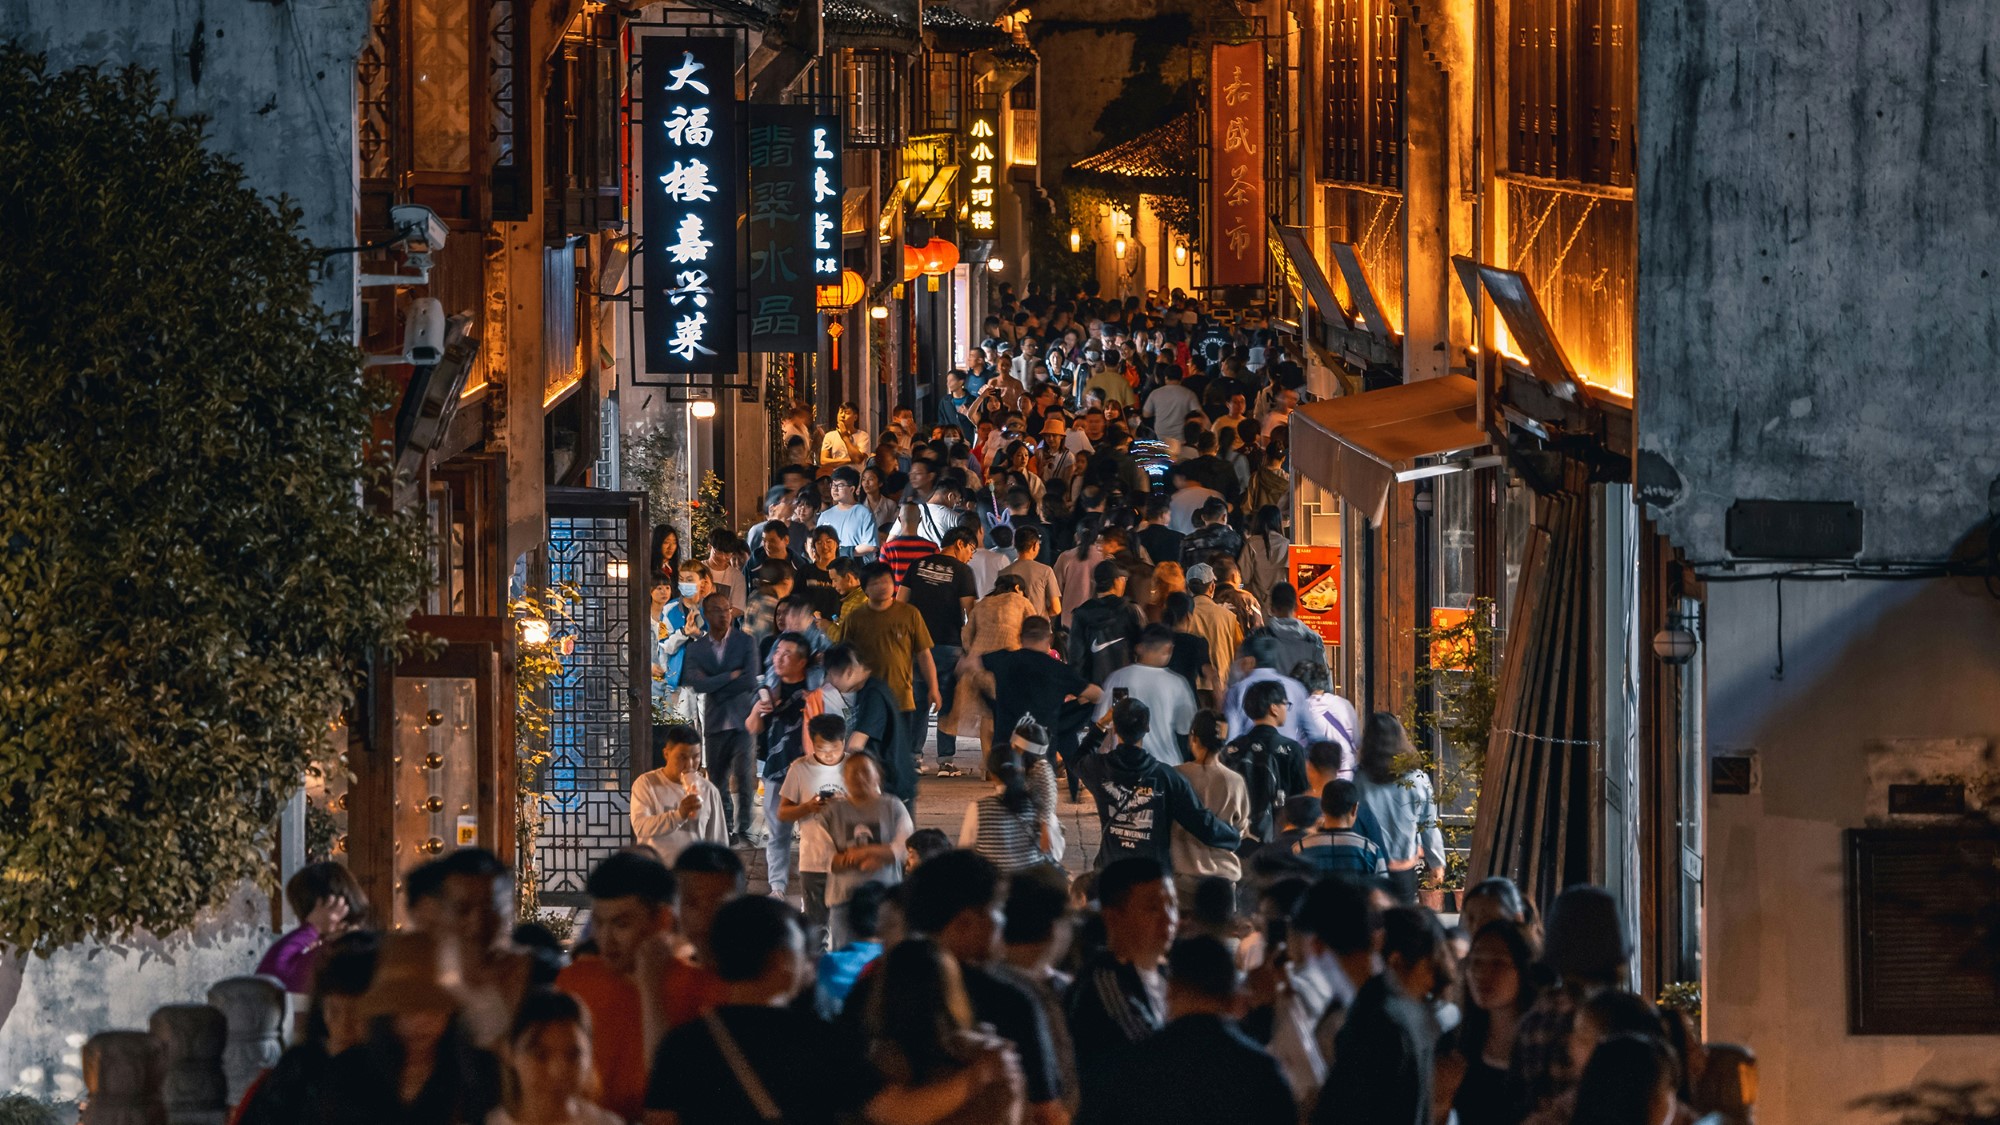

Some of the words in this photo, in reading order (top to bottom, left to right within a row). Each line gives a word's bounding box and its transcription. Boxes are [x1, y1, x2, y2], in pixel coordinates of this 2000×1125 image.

[659, 50, 719, 361] 大福楼嘉兴菜
[750, 124, 801, 335] 翡翠水晶
[970, 118, 995, 230] 小小月河楼
